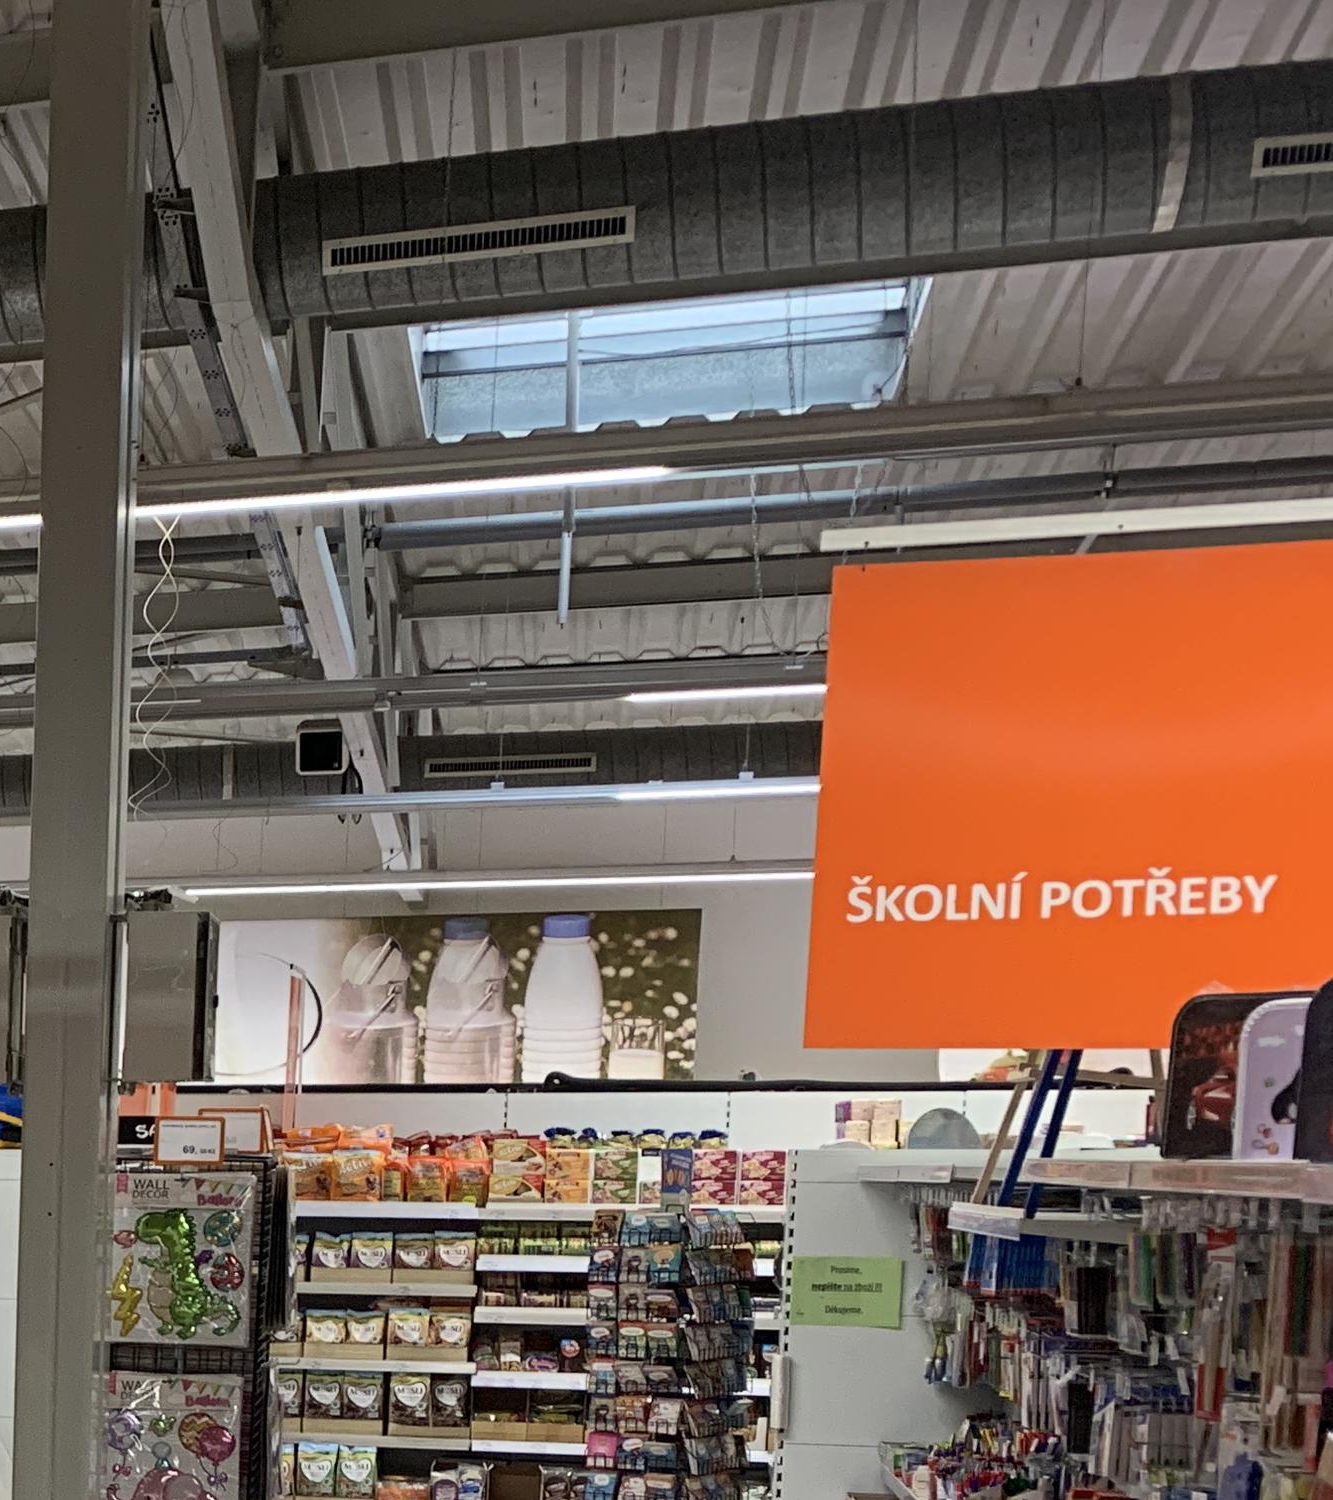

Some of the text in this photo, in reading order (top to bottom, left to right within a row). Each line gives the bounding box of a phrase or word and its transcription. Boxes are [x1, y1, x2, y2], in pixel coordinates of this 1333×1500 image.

[846, 867, 1278, 923] ŠKOLNÍ POTŘEBY
[134, 1179, 170, 1190] WALL
[133, 1190, 169, 1199] DECOR
[825, 1305, 863, 1315] Děkujeme.
